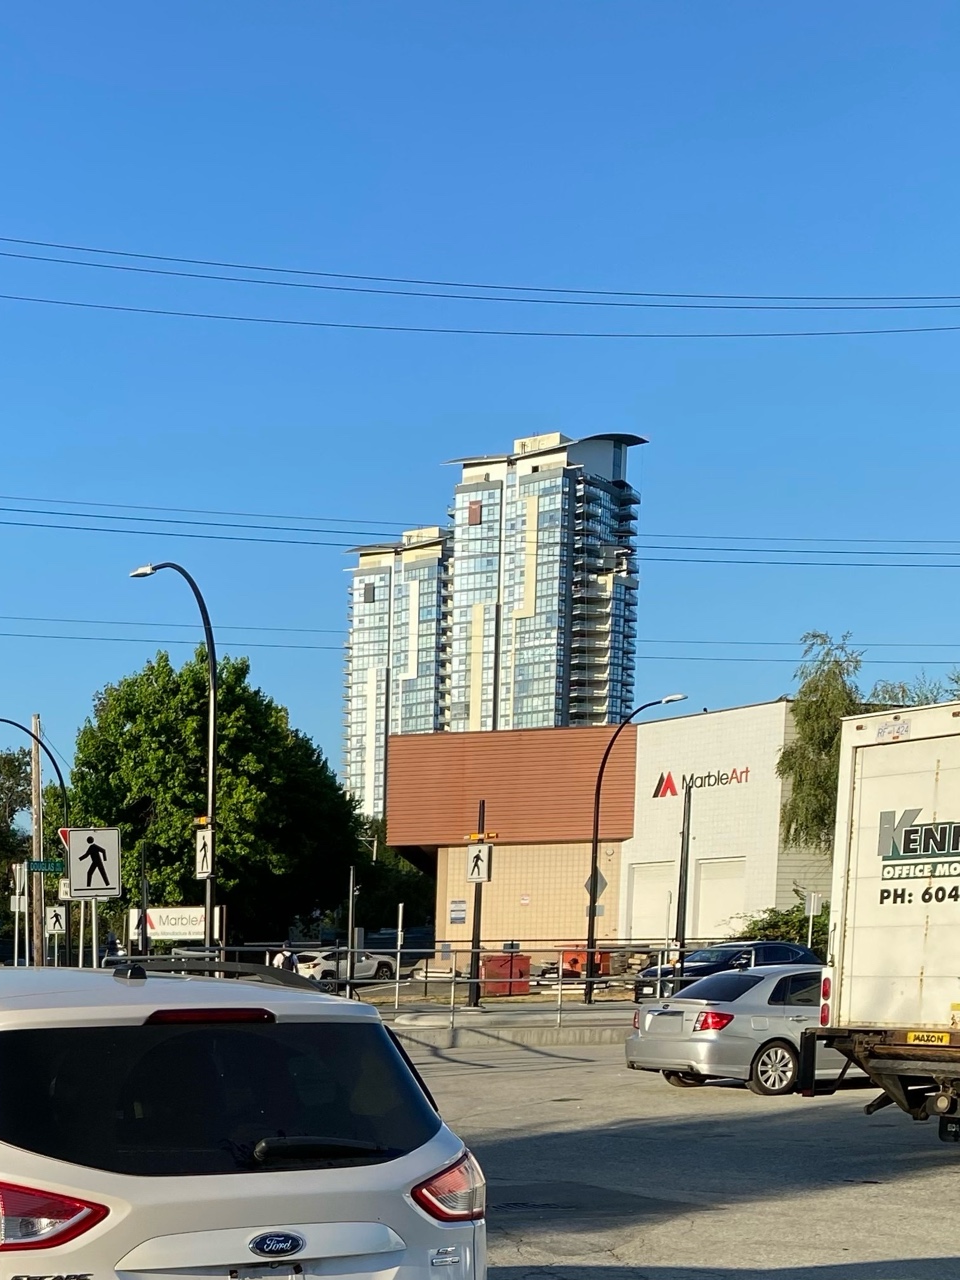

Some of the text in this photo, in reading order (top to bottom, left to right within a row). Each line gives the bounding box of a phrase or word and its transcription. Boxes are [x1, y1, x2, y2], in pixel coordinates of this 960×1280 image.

[681, 766, 750, 790] MarbleArt
[30, 862, 55, 872] DOUGLAS
[883, 864, 932, 879] OFFICE
[879, 888, 913, 905] PH:
[159, 914, 206, 927] MarbleA
[912, 1034, 944, 1043] MAXON
[263, 1236, 293, 1252] Ford
